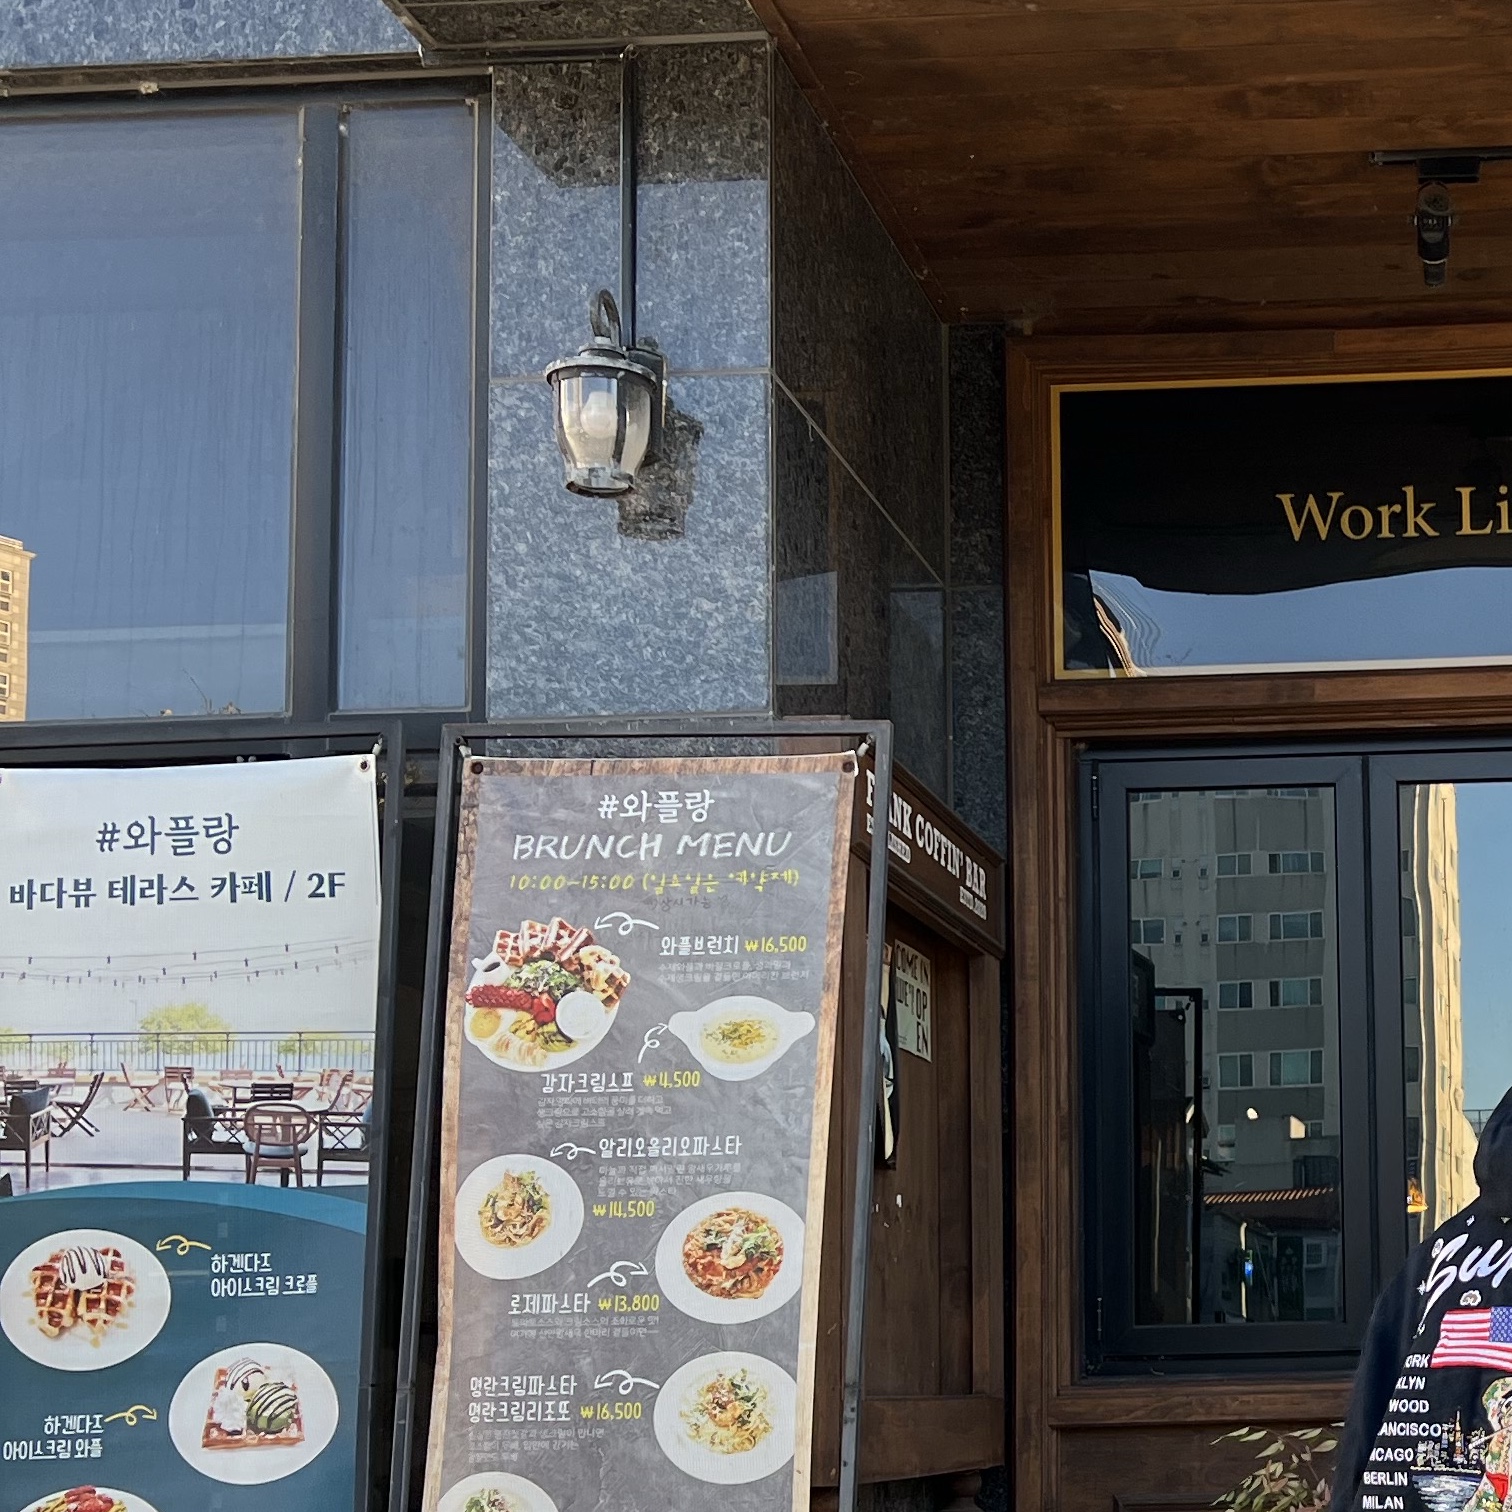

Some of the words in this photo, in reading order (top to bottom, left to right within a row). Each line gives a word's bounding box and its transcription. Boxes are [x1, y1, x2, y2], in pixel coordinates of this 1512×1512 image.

[1276, 485, 1440, 542] Work
[597, 789, 715, 823] #와플랑
[95, 813, 240, 857] #와플랑
[512, 832, 661, 862] BRUNCH
[677, 831, 793, 859] MENU
[965, 855, 987, 900] BAR
[9, 876, 97, 911] 바다뷰
[108, 873, 200, 907] 테라스
[210, 870, 272, 904] 카페
[307, 872, 346, 899] 2F
[659, 934, 739, 956] 와플브런치
[541, 1072, 634, 1093] 감자크림스프
[599, 1135, 743, 1158] 알리오올리오파스타
[210, 1252, 272, 1274] 하겐다즈
[210, 1275, 280, 1298] 아이스크림
[282, 1274, 318, 1296] 크로플
[507, 1292, 591, 1314] 로제파스타
[470, 1374, 578, 1397] 명란크림파스타
[468, 1400, 571, 1423] 명란크림리조또
[43, 1413, 105, 1436] 하겐다즈
[1378, 1422, 1442, 1437] ANCISCO
[3, 1439, 71, 1461] 아이스크림
[74, 1438, 104, 1459] 와플
[1363, 1471, 1408, 1486] BERLIN
[1362, 1495, 1404, 1510] MILAN
